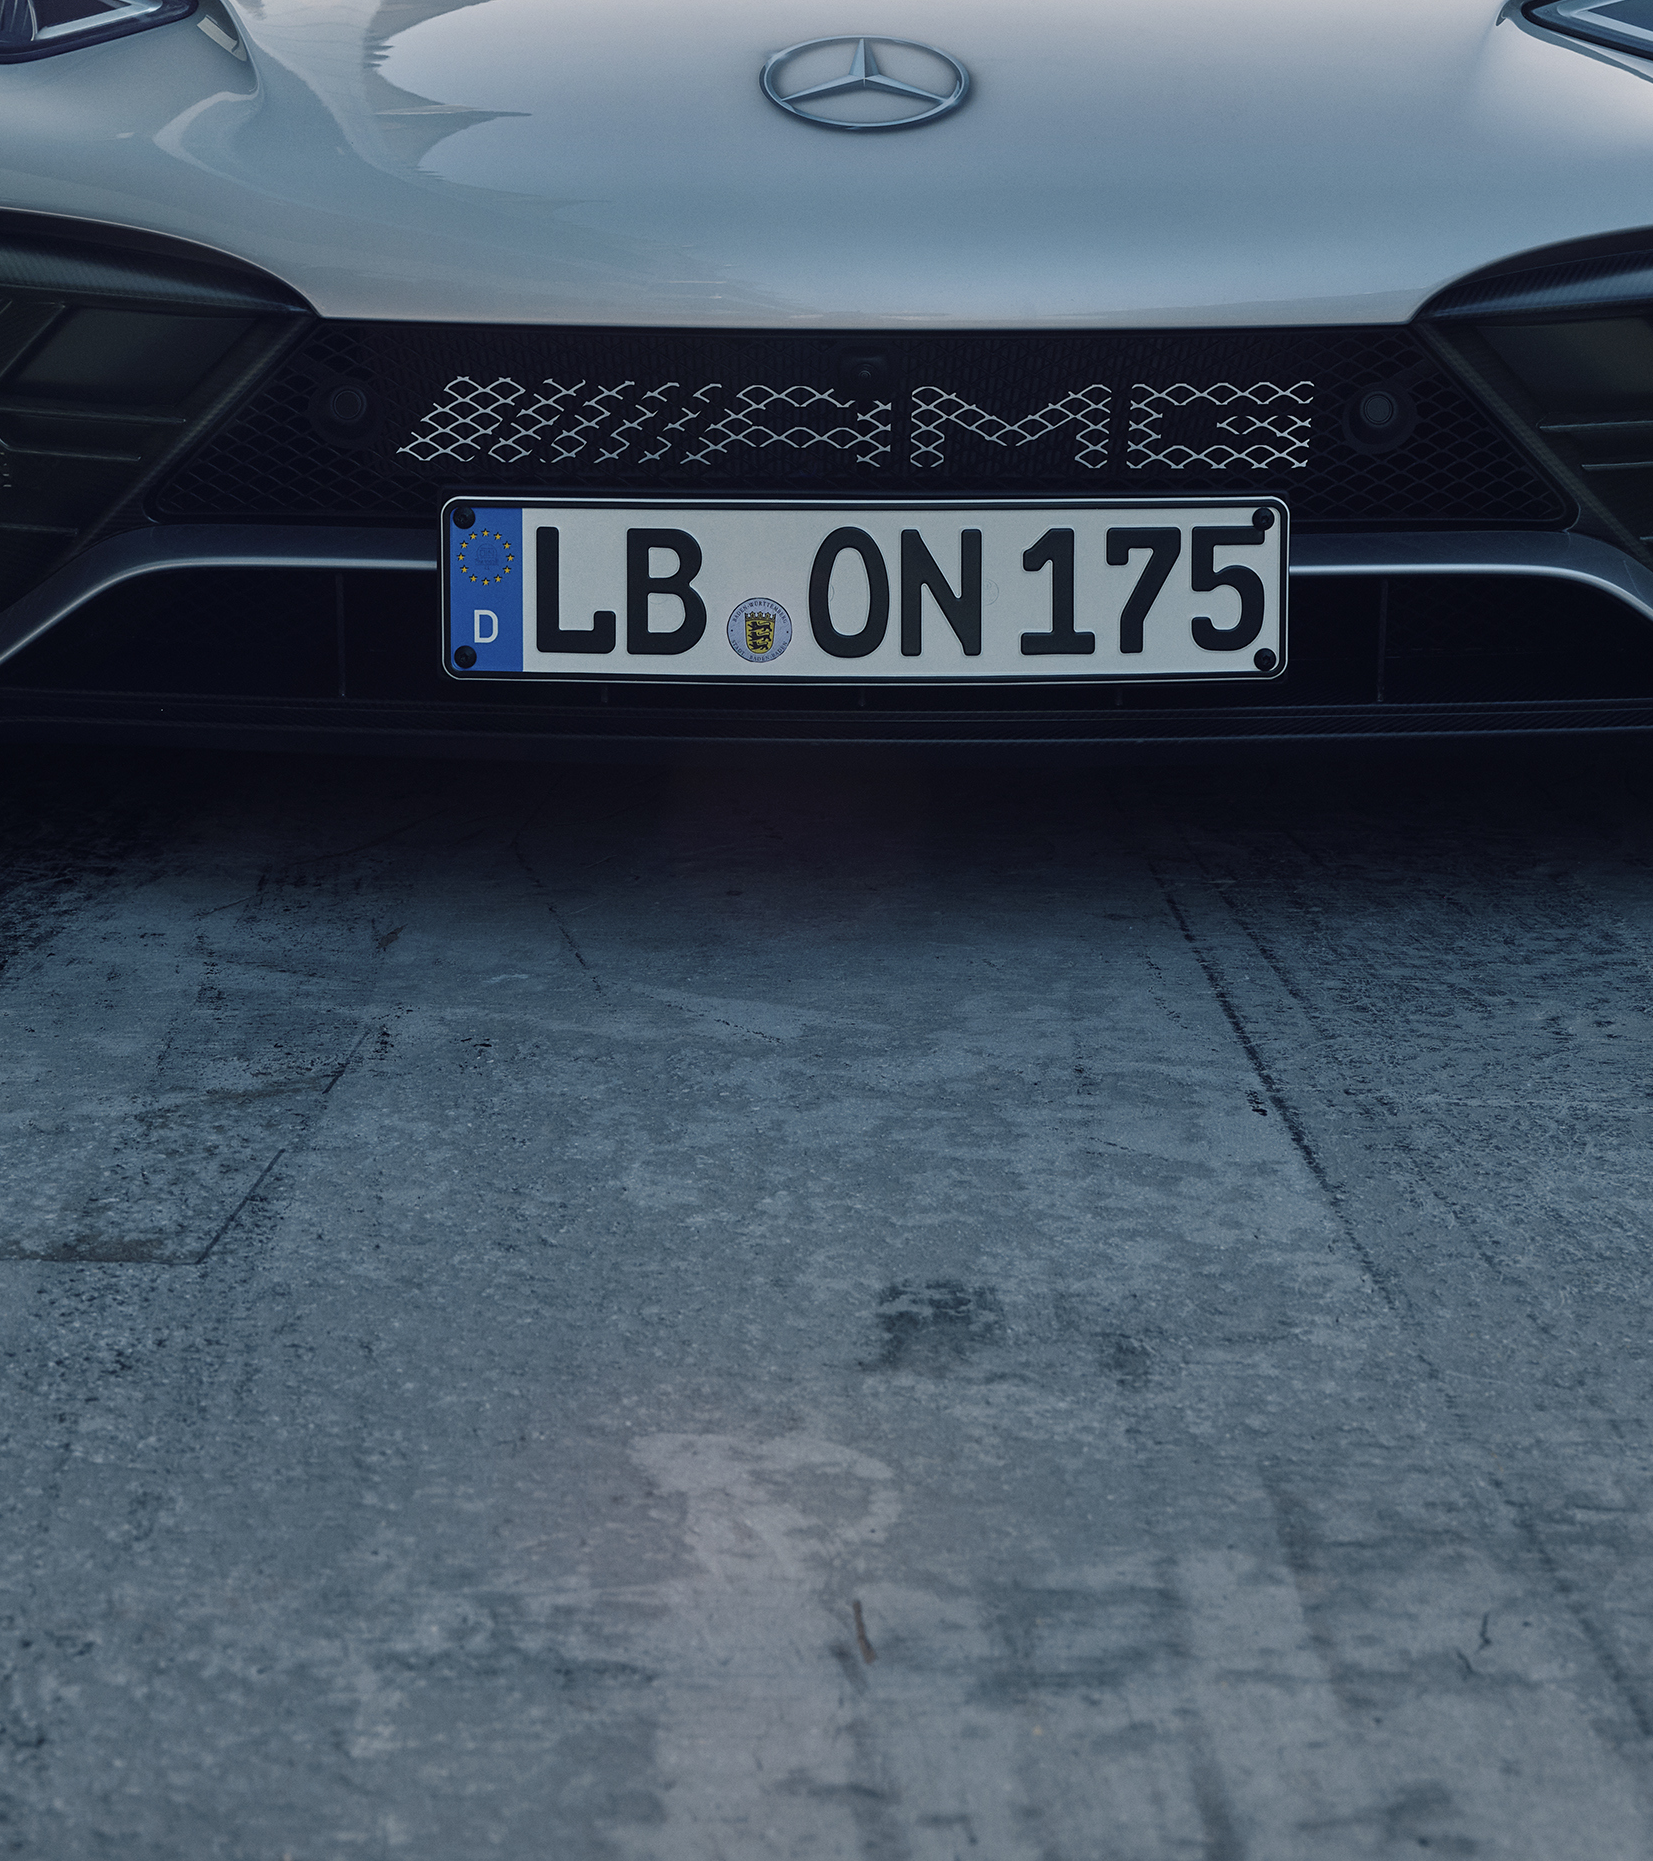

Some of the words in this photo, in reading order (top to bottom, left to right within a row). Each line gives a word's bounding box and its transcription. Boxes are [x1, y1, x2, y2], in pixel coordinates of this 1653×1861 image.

[678, 382, 1315, 470] AMG
[473, 609, 499, 644] D
[535, 525, 708, 655] LB
[808, 525, 983, 658] ON
[1019, 525, 1266, 656] 175
